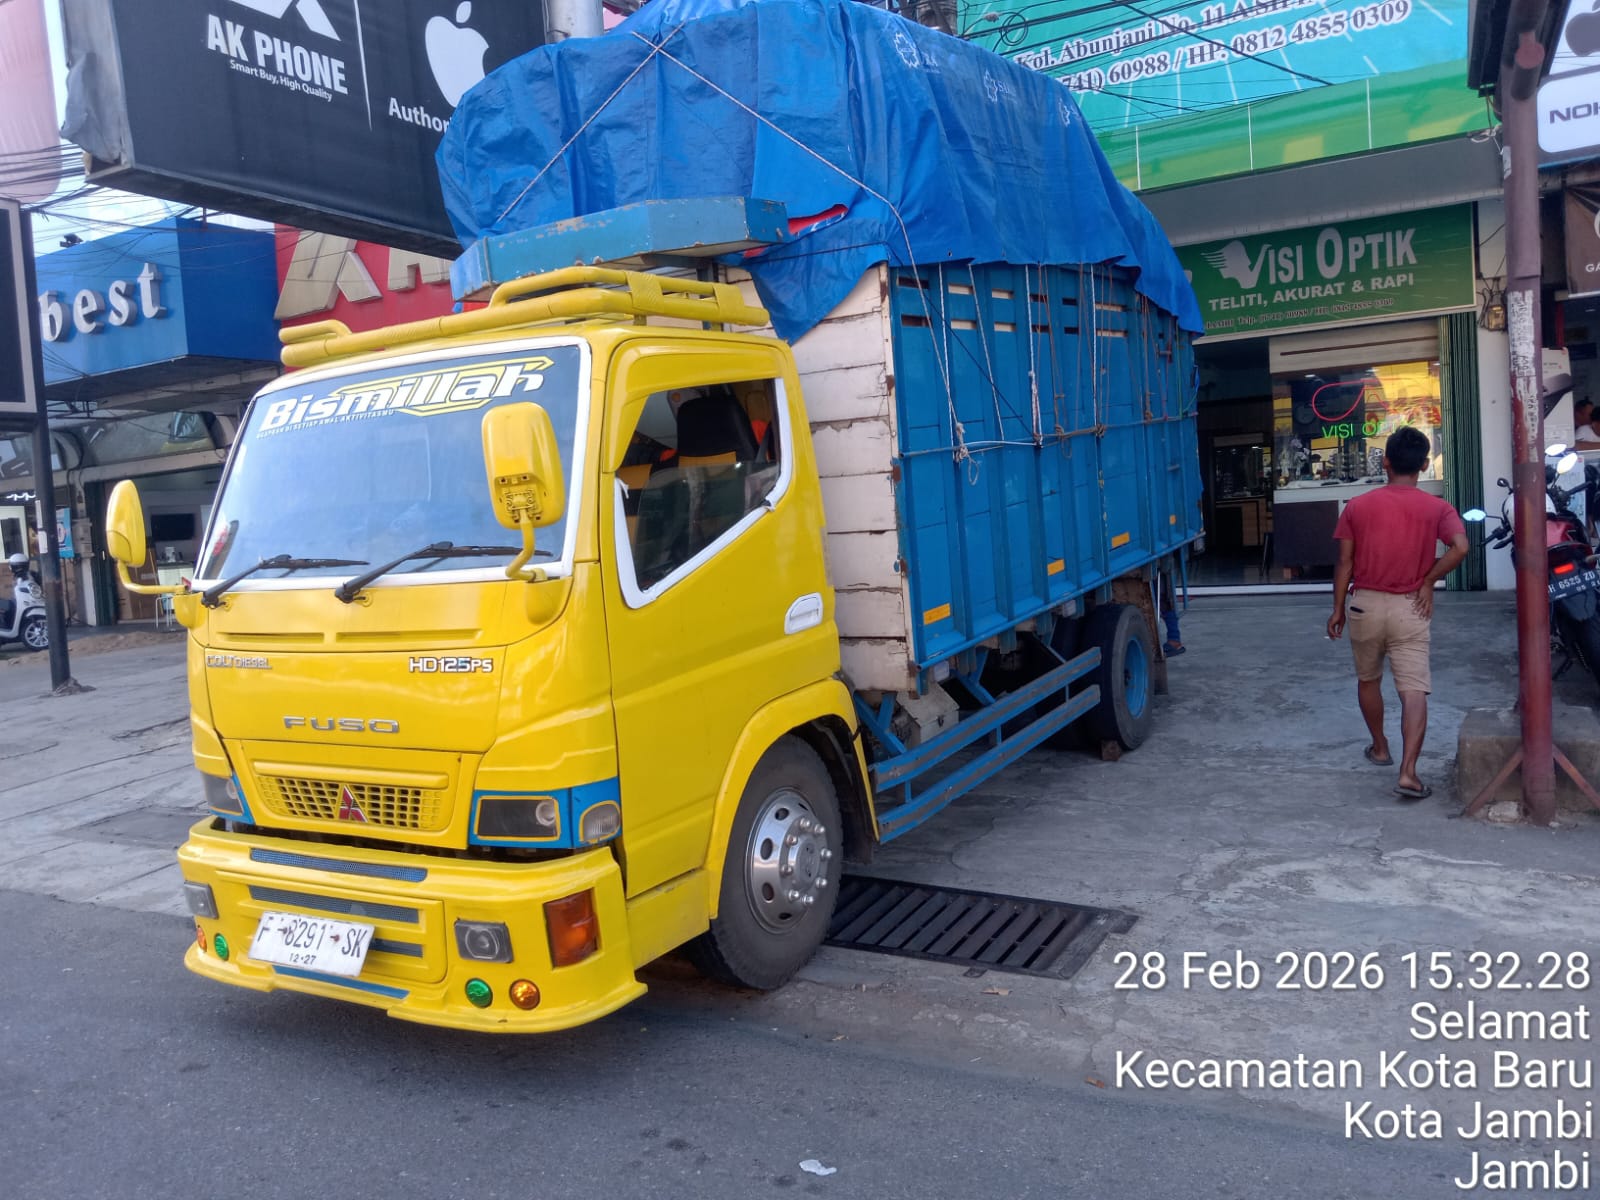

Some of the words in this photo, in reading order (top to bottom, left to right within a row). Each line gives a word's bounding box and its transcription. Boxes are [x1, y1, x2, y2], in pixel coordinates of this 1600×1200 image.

[207, 14, 248, 61] AK
[254, 30, 348, 95] PHONE
[1016, 48, 1055, 69] Kol.
[1061, 20, 1152, 61] Abunjani
[1162, 15, 1196, 36] No.
[1061, 70, 1103, 91] 741)
[1109, 57, 1169, 83] 60988
[1189, 43, 1227, 67] HP.
[1232, 28, 1284, 54] 0812
[1291, 14, 1345, 43] 4855
[1353, 1, 1409, 30] 0309
[230, 59, 258, 77] Smart
[259, 69, 279, 84] Buy,
[280, 77, 301, 92] High
[302, 84, 332, 102] Quality
[388, 97, 454, 133] Author
[1210, 238, 1304, 289] VISI
[1316, 227, 1417, 279] OPTIK
[38, 262, 167, 342] best
[1209, 293, 1268, 311] TELITI,
[1273, 282, 1345, 304] AKURAT
[1352, 278, 1365, 293] &
[1371, 272, 1414, 290] RAPI
[259, 364, 544, 432] Bismillah
[1321, 423, 1354, 439] VISI
[283, 716, 400, 733] FUSO
[284, 918, 327, 951] 8291
[342, 927, 368, 958] SK
